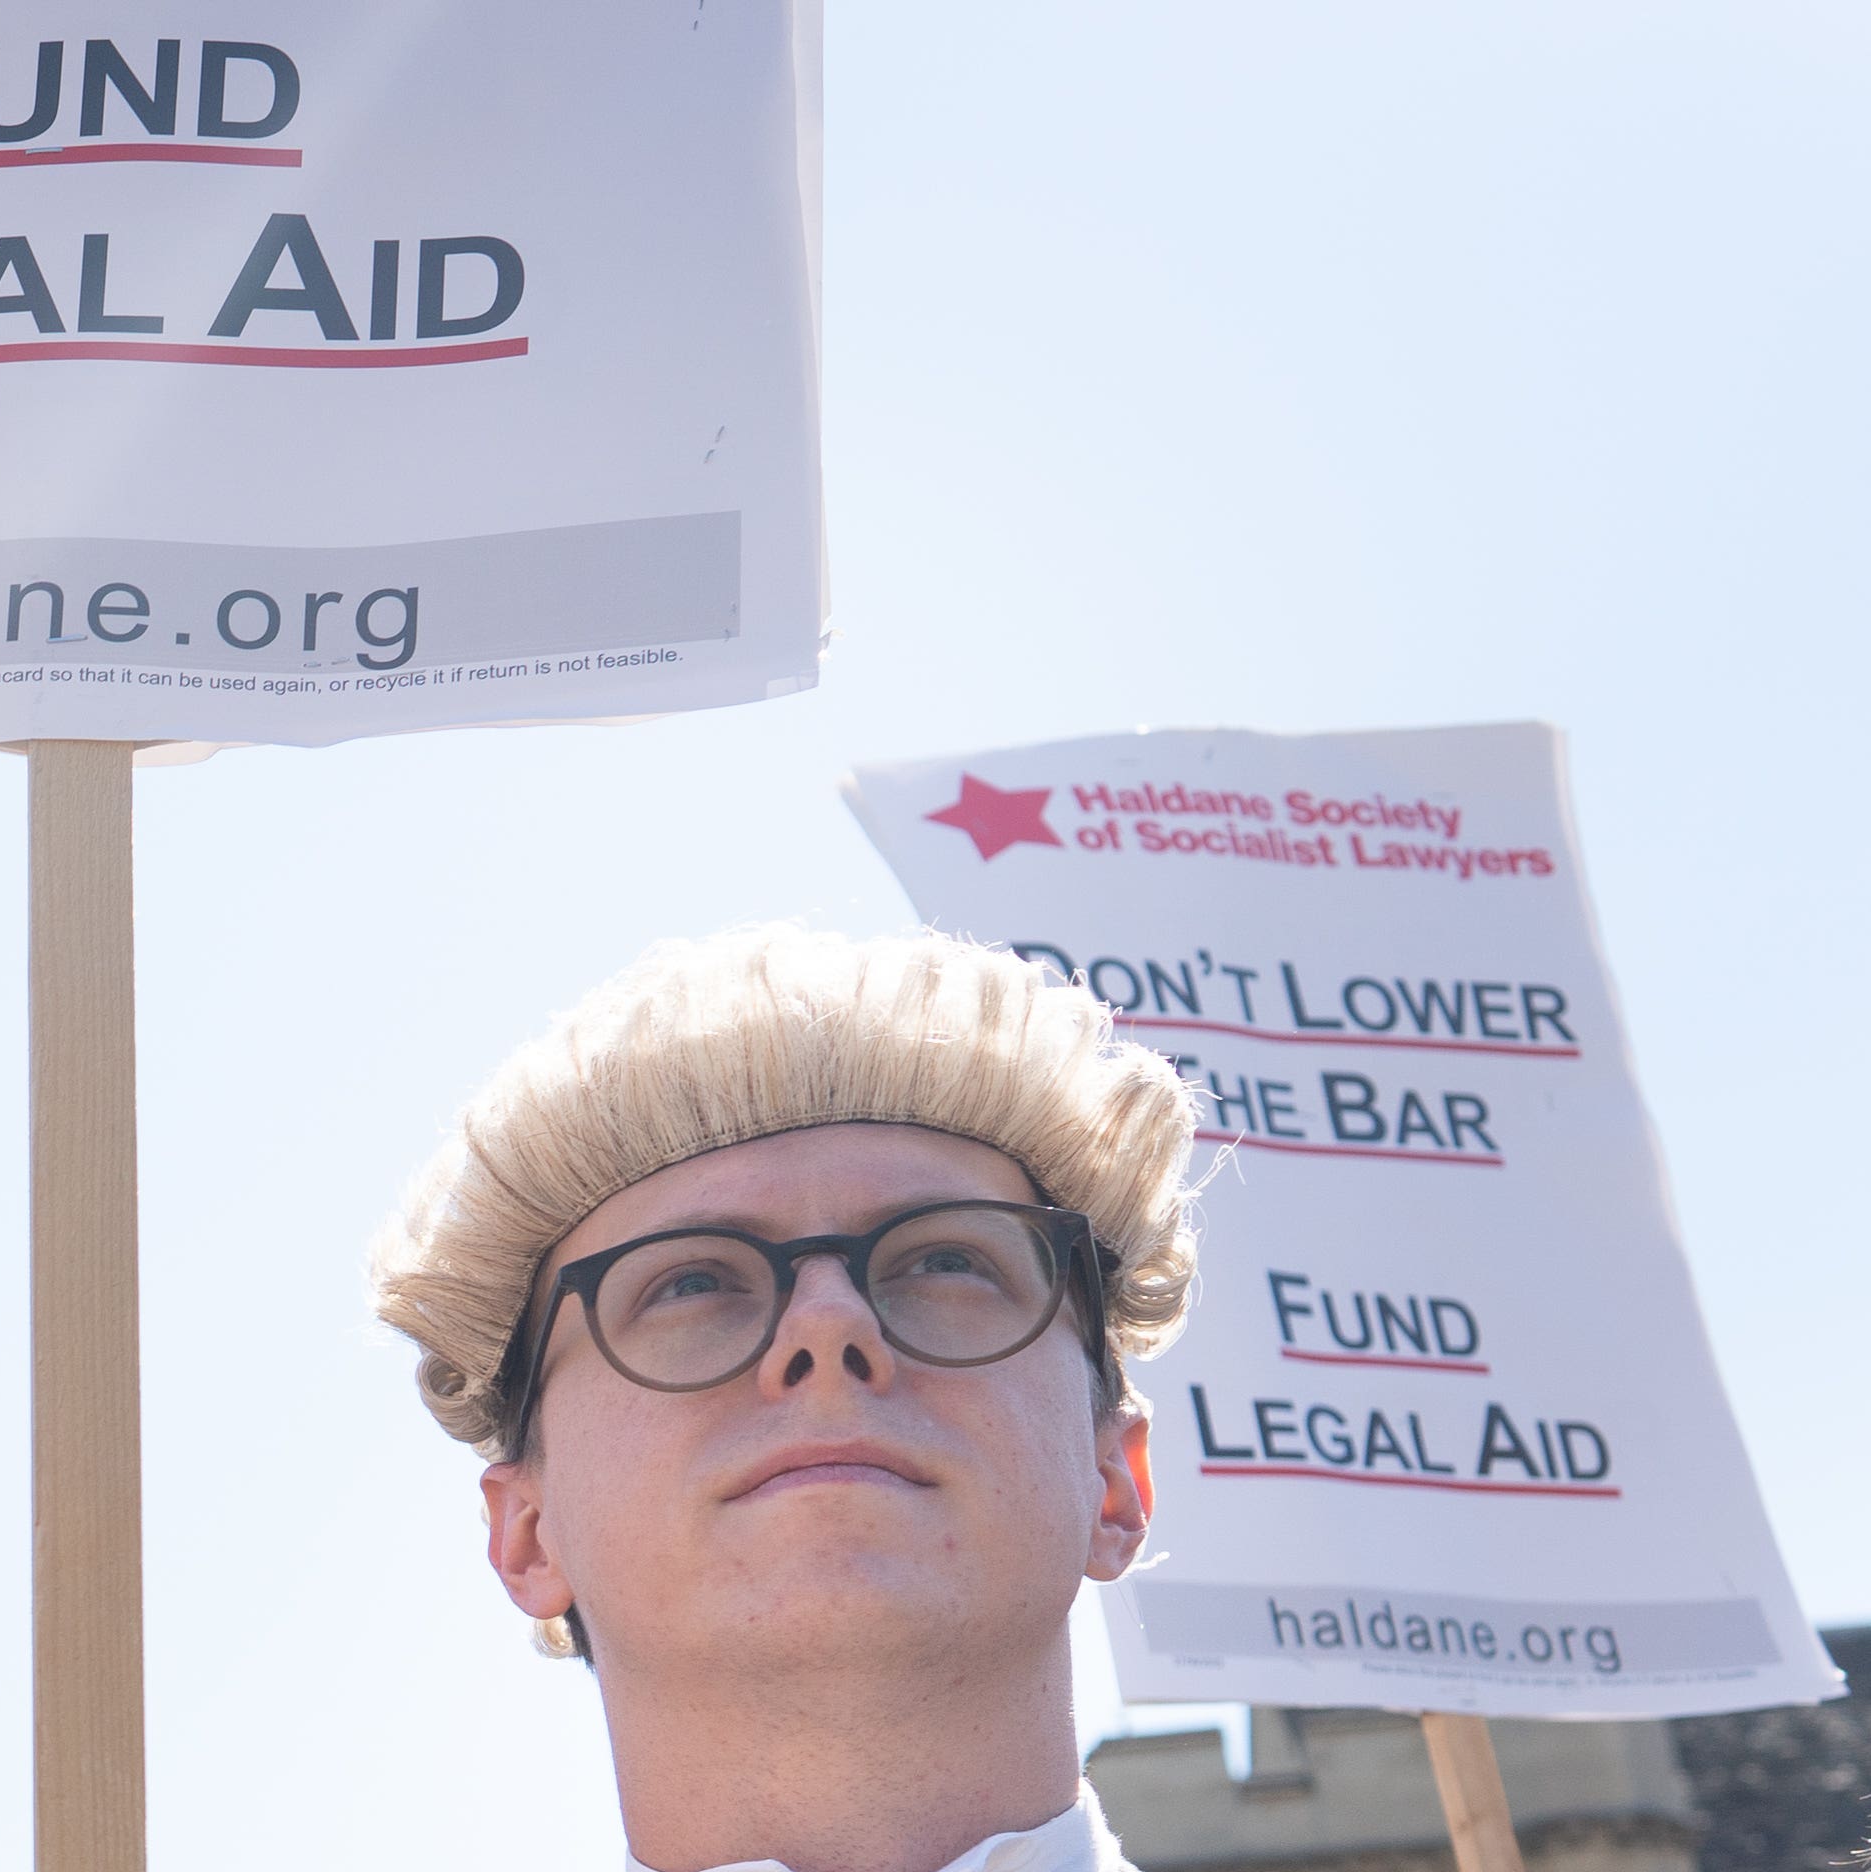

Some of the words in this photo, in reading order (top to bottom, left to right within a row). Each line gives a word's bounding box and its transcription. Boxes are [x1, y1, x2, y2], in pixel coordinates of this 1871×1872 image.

[208, 214, 524, 340] AID
[50, 669, 72, 681] so
[79, 667, 115, 682] that
[121, 668, 132, 683] it
[138, 672, 173, 686] can
[179, 673, 203, 688] be
[209, 674, 256, 691] used
[263, 678, 323, 696] again,
[329, 679, 349, 691] or
[355, 671, 426, 692] recycle
[432, 669, 444, 684] it
[451, 668, 462, 683] if
[468, 663, 528, 681] return
[535, 658, 551, 675] is
[558, 655, 591, 673] not
[596, 647, 684, 669] feasible.
[1073, 784, 1271, 825] Haldane
[1286, 791, 1460, 841] Society
[1077, 820, 1120, 849] of
[1135, 821, 1341, 866] Socialist
[1350, 833, 1554, 879] Lawyers
[1281, 963, 1575, 1042] LOWER
[1321, 1072, 1497, 1151] BAR
[1268, 1271, 1479, 1357] FUND
[1190, 1385, 1454, 1474] LEGAL
[1477, 1404, 1609, 1480] AID
[1269, 1600, 1621, 1674] haldane.org
